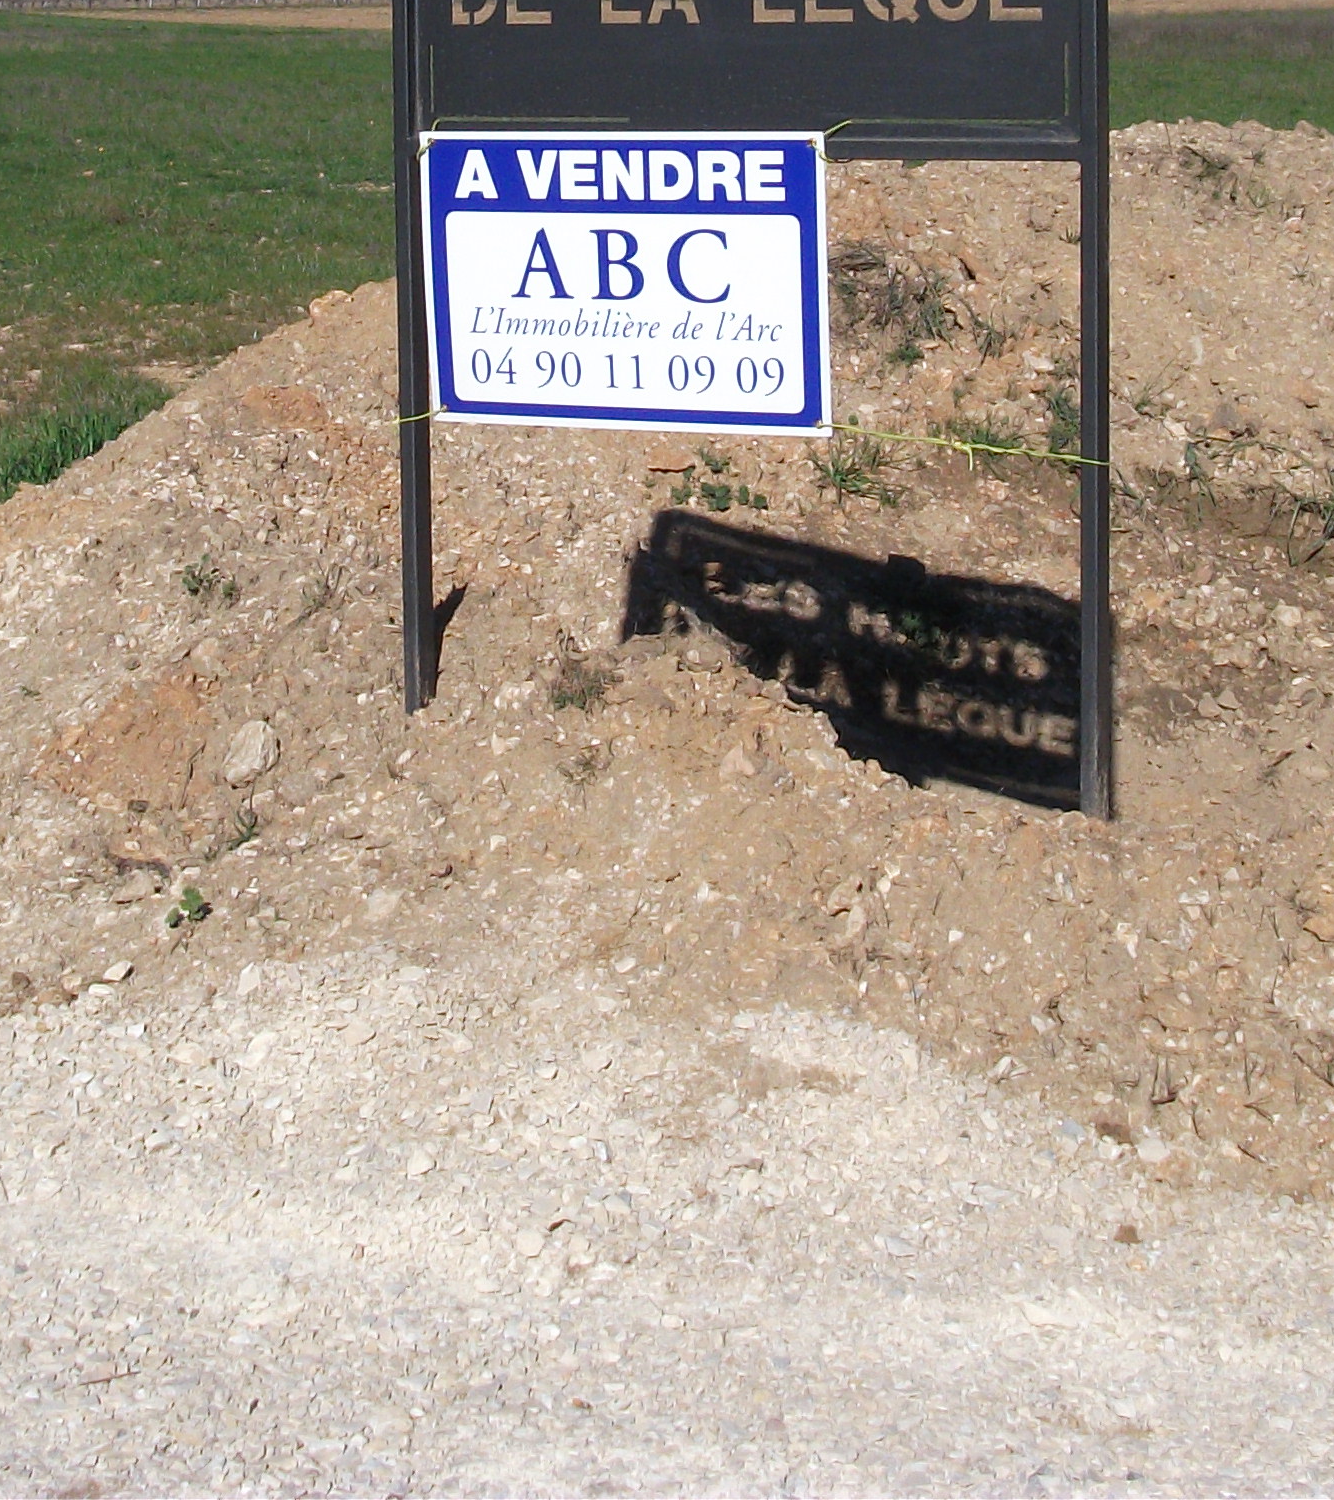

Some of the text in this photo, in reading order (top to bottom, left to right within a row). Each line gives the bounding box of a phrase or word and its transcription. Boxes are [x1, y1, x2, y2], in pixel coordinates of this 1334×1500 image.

[454, 148, 787, 202] A VENDRE
[671, 310, 703, 341] de
[471, 346, 786, 397] 04 90 11 09 09
